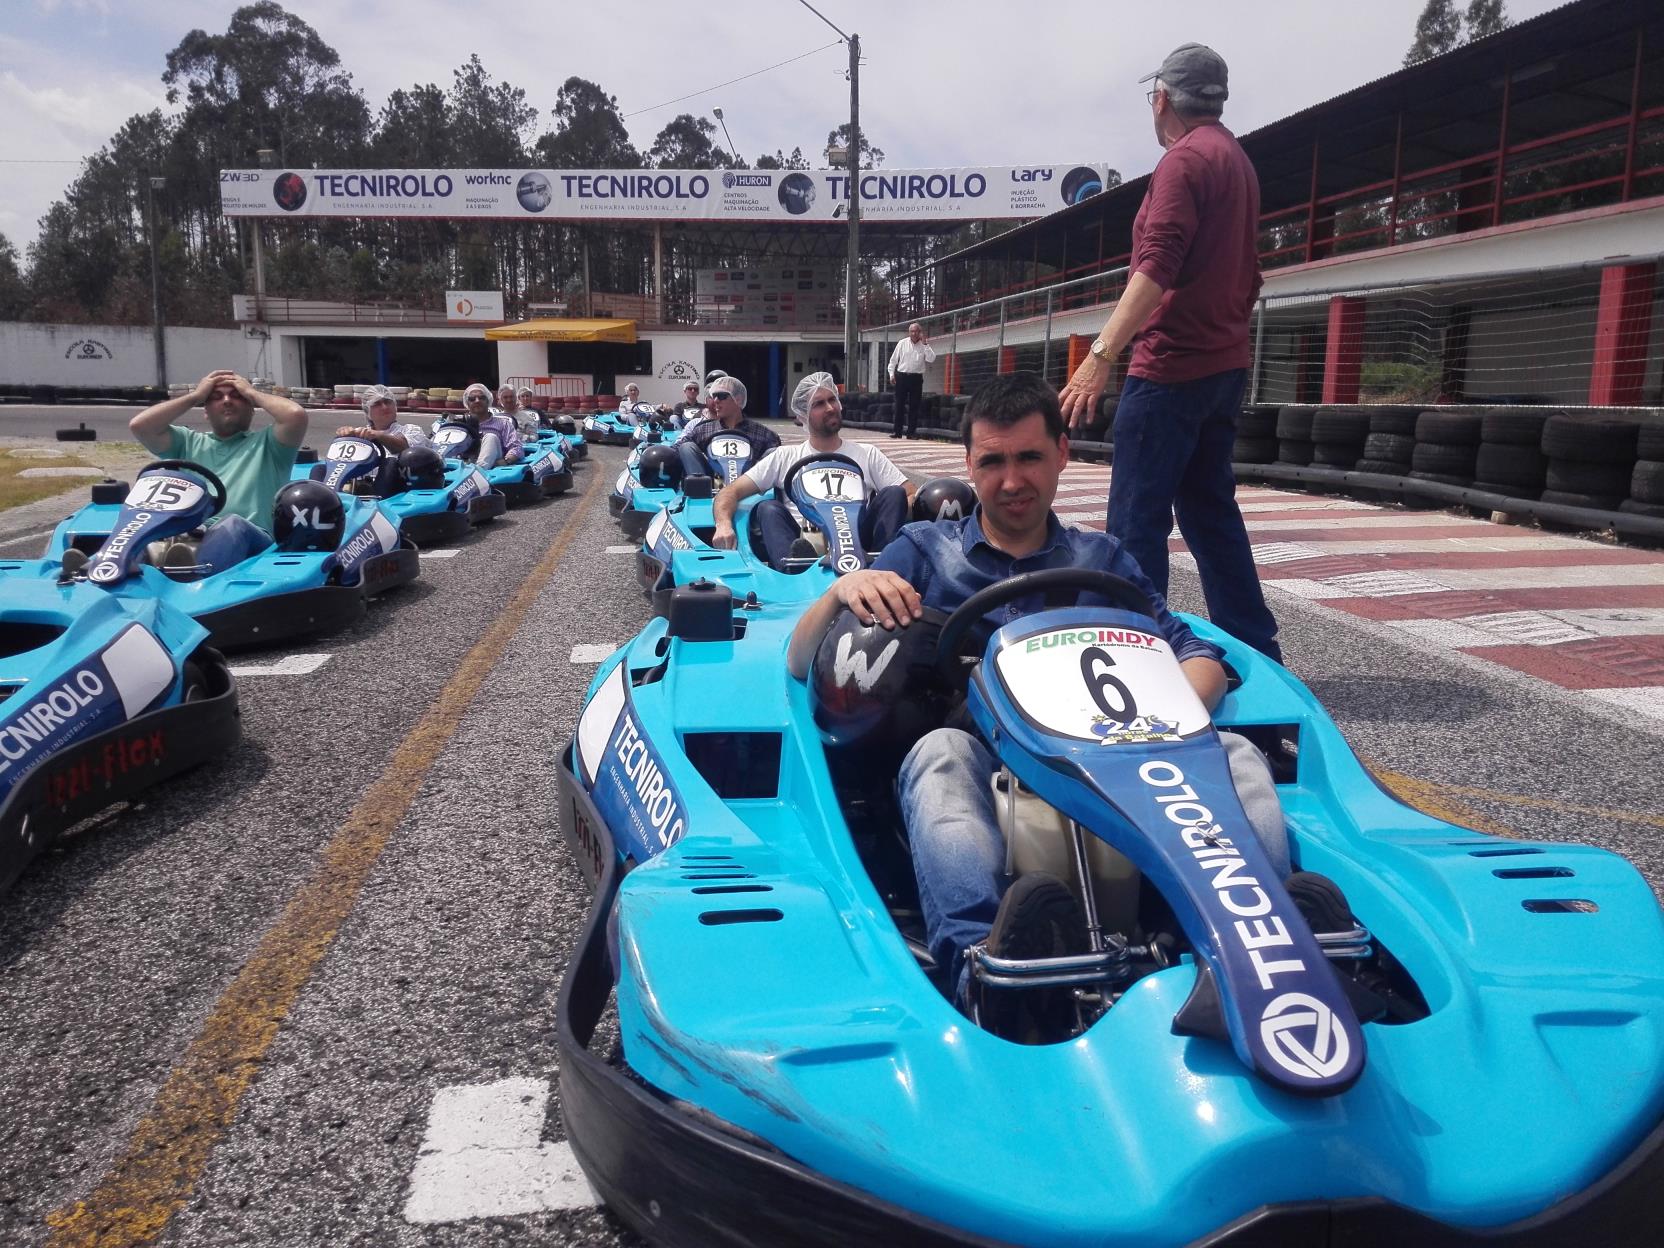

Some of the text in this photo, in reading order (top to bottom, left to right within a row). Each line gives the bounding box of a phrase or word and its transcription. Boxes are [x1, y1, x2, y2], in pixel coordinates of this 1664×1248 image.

[314, 174, 453, 198] TECNIROLO
[465, 172, 512, 185] worknc
[561, 175, 709, 199] TECNIROLO
[739, 176, 769, 185] HURON
[338, 443, 357, 459] 19
[722, 442, 738, 456] 13
[658, 461, 671, 480] L
[145, 481, 187, 505] 15
[820, 472, 845, 496] 17
[291, 505, 337, 531] XL
[935, 498, 964, 521] M
[1025, 630, 1156, 653] EUROINDY
[834, 632, 900, 694] W
[1079, 646, 1138, 723] 6
[1102, 717, 1154, 735] 24
[1138, 760, 1307, 991] TECNIROLO
